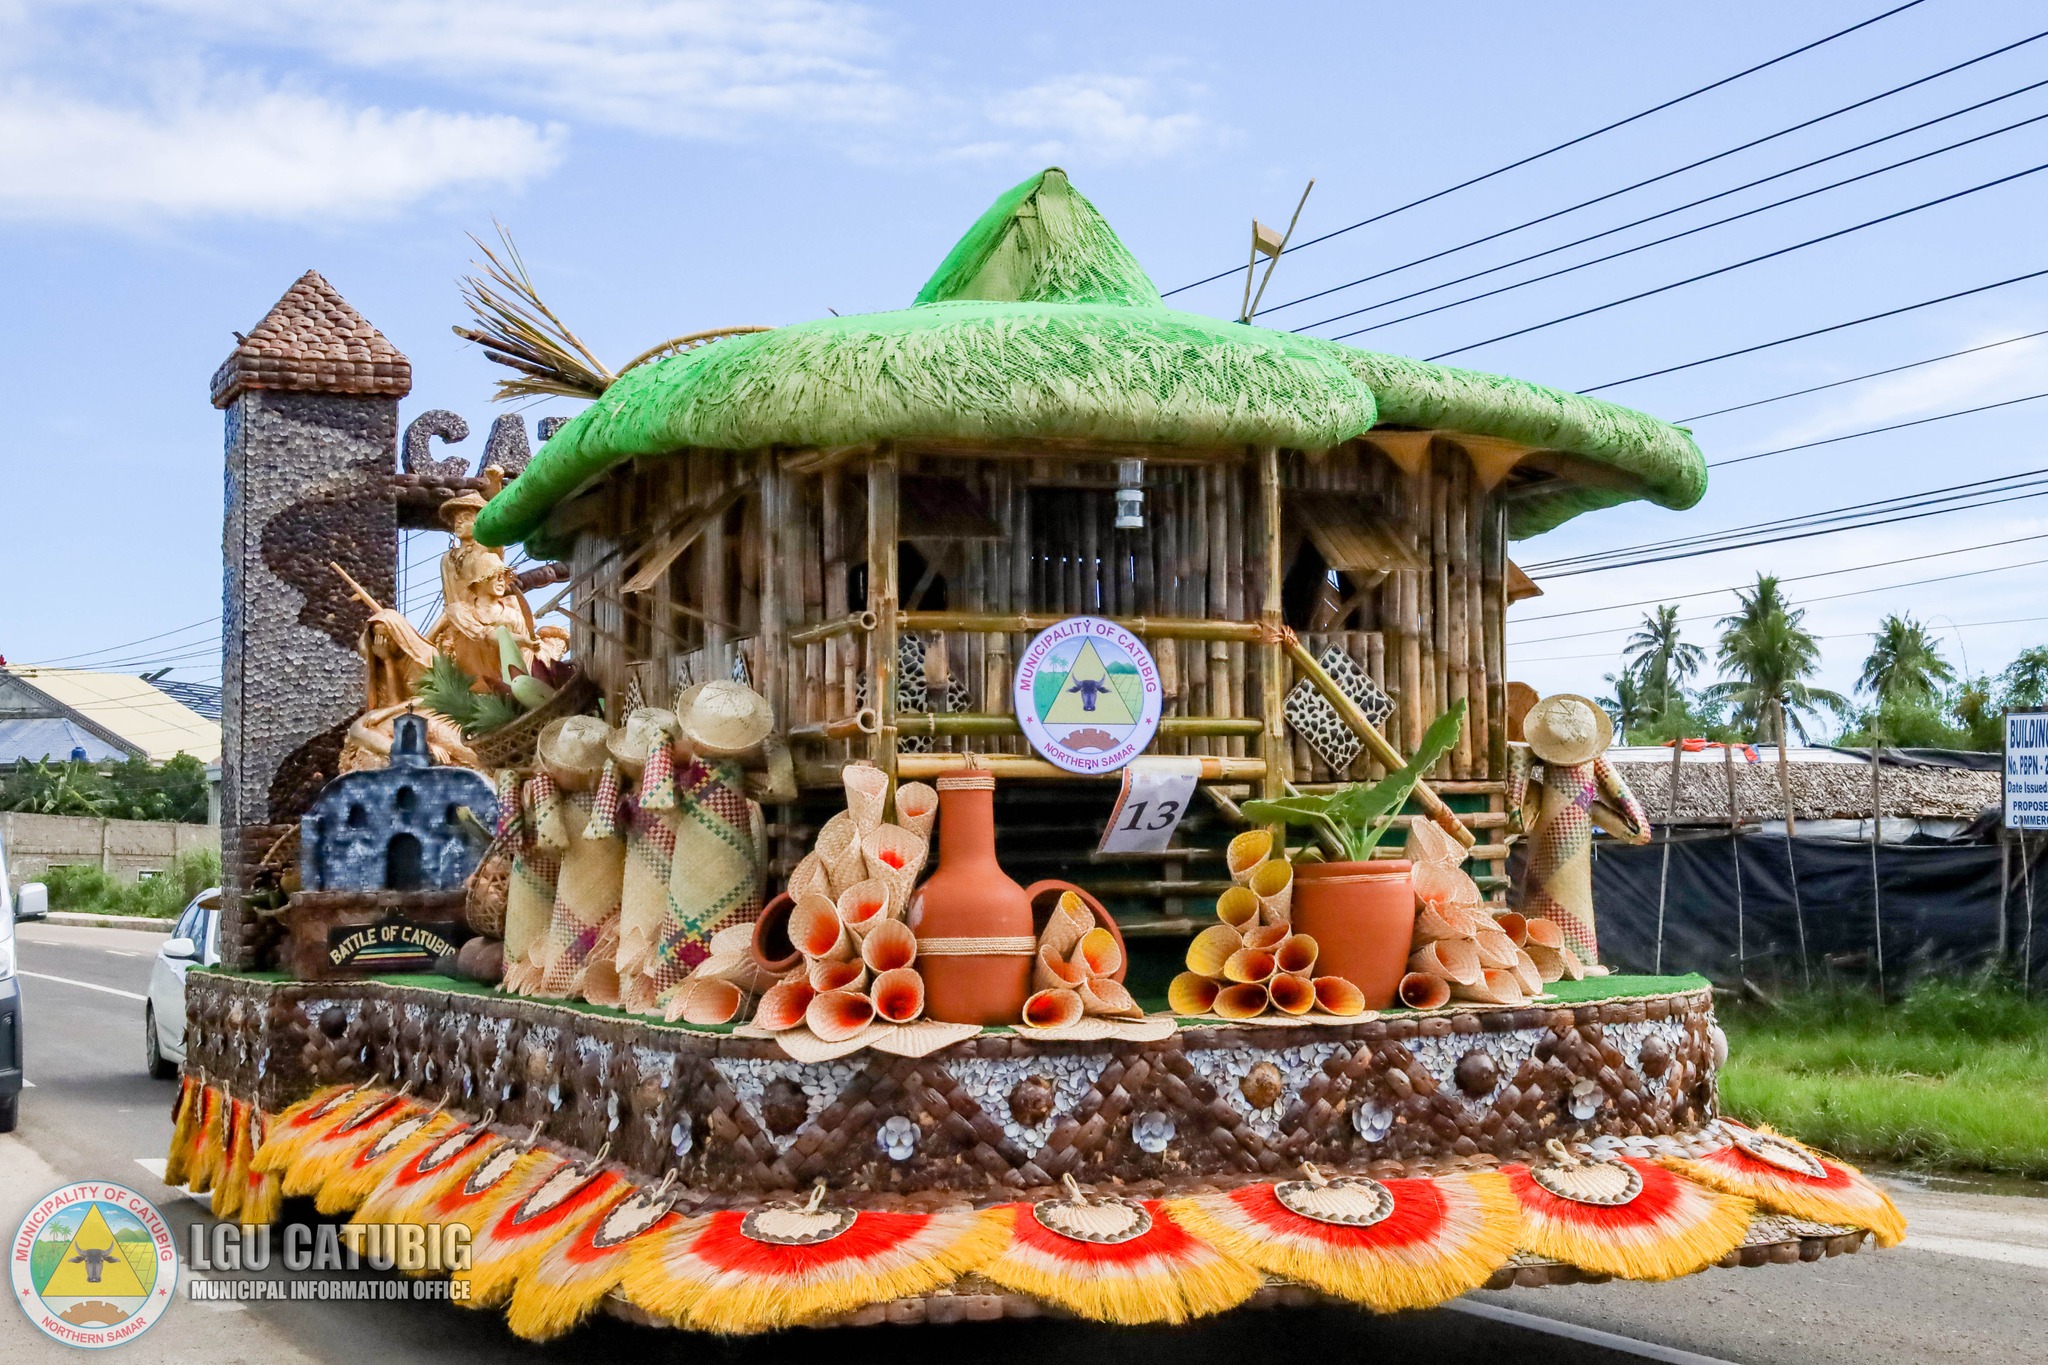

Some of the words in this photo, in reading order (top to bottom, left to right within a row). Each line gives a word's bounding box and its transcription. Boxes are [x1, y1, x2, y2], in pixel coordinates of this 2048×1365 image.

[401, 409, 571, 479] CA
[1020, 621, 1091, 691] MUNICIPALITY
[1096, 623, 1115, 636] OF
[1118, 634, 1157, 693] CATUBIG
[1044, 742, 1099, 768] NORTHERN
[1101, 743, 1135, 767] SAMAR
[2007, 781, 2023, 793] Date
[2024, 781, 2048, 793] Issued
[1120, 800, 1179, 831] 13
[2013, 815, 2048, 825] COMMER
[329, 928, 377, 965] BATTLE
[381, 926, 399, 941] OF
